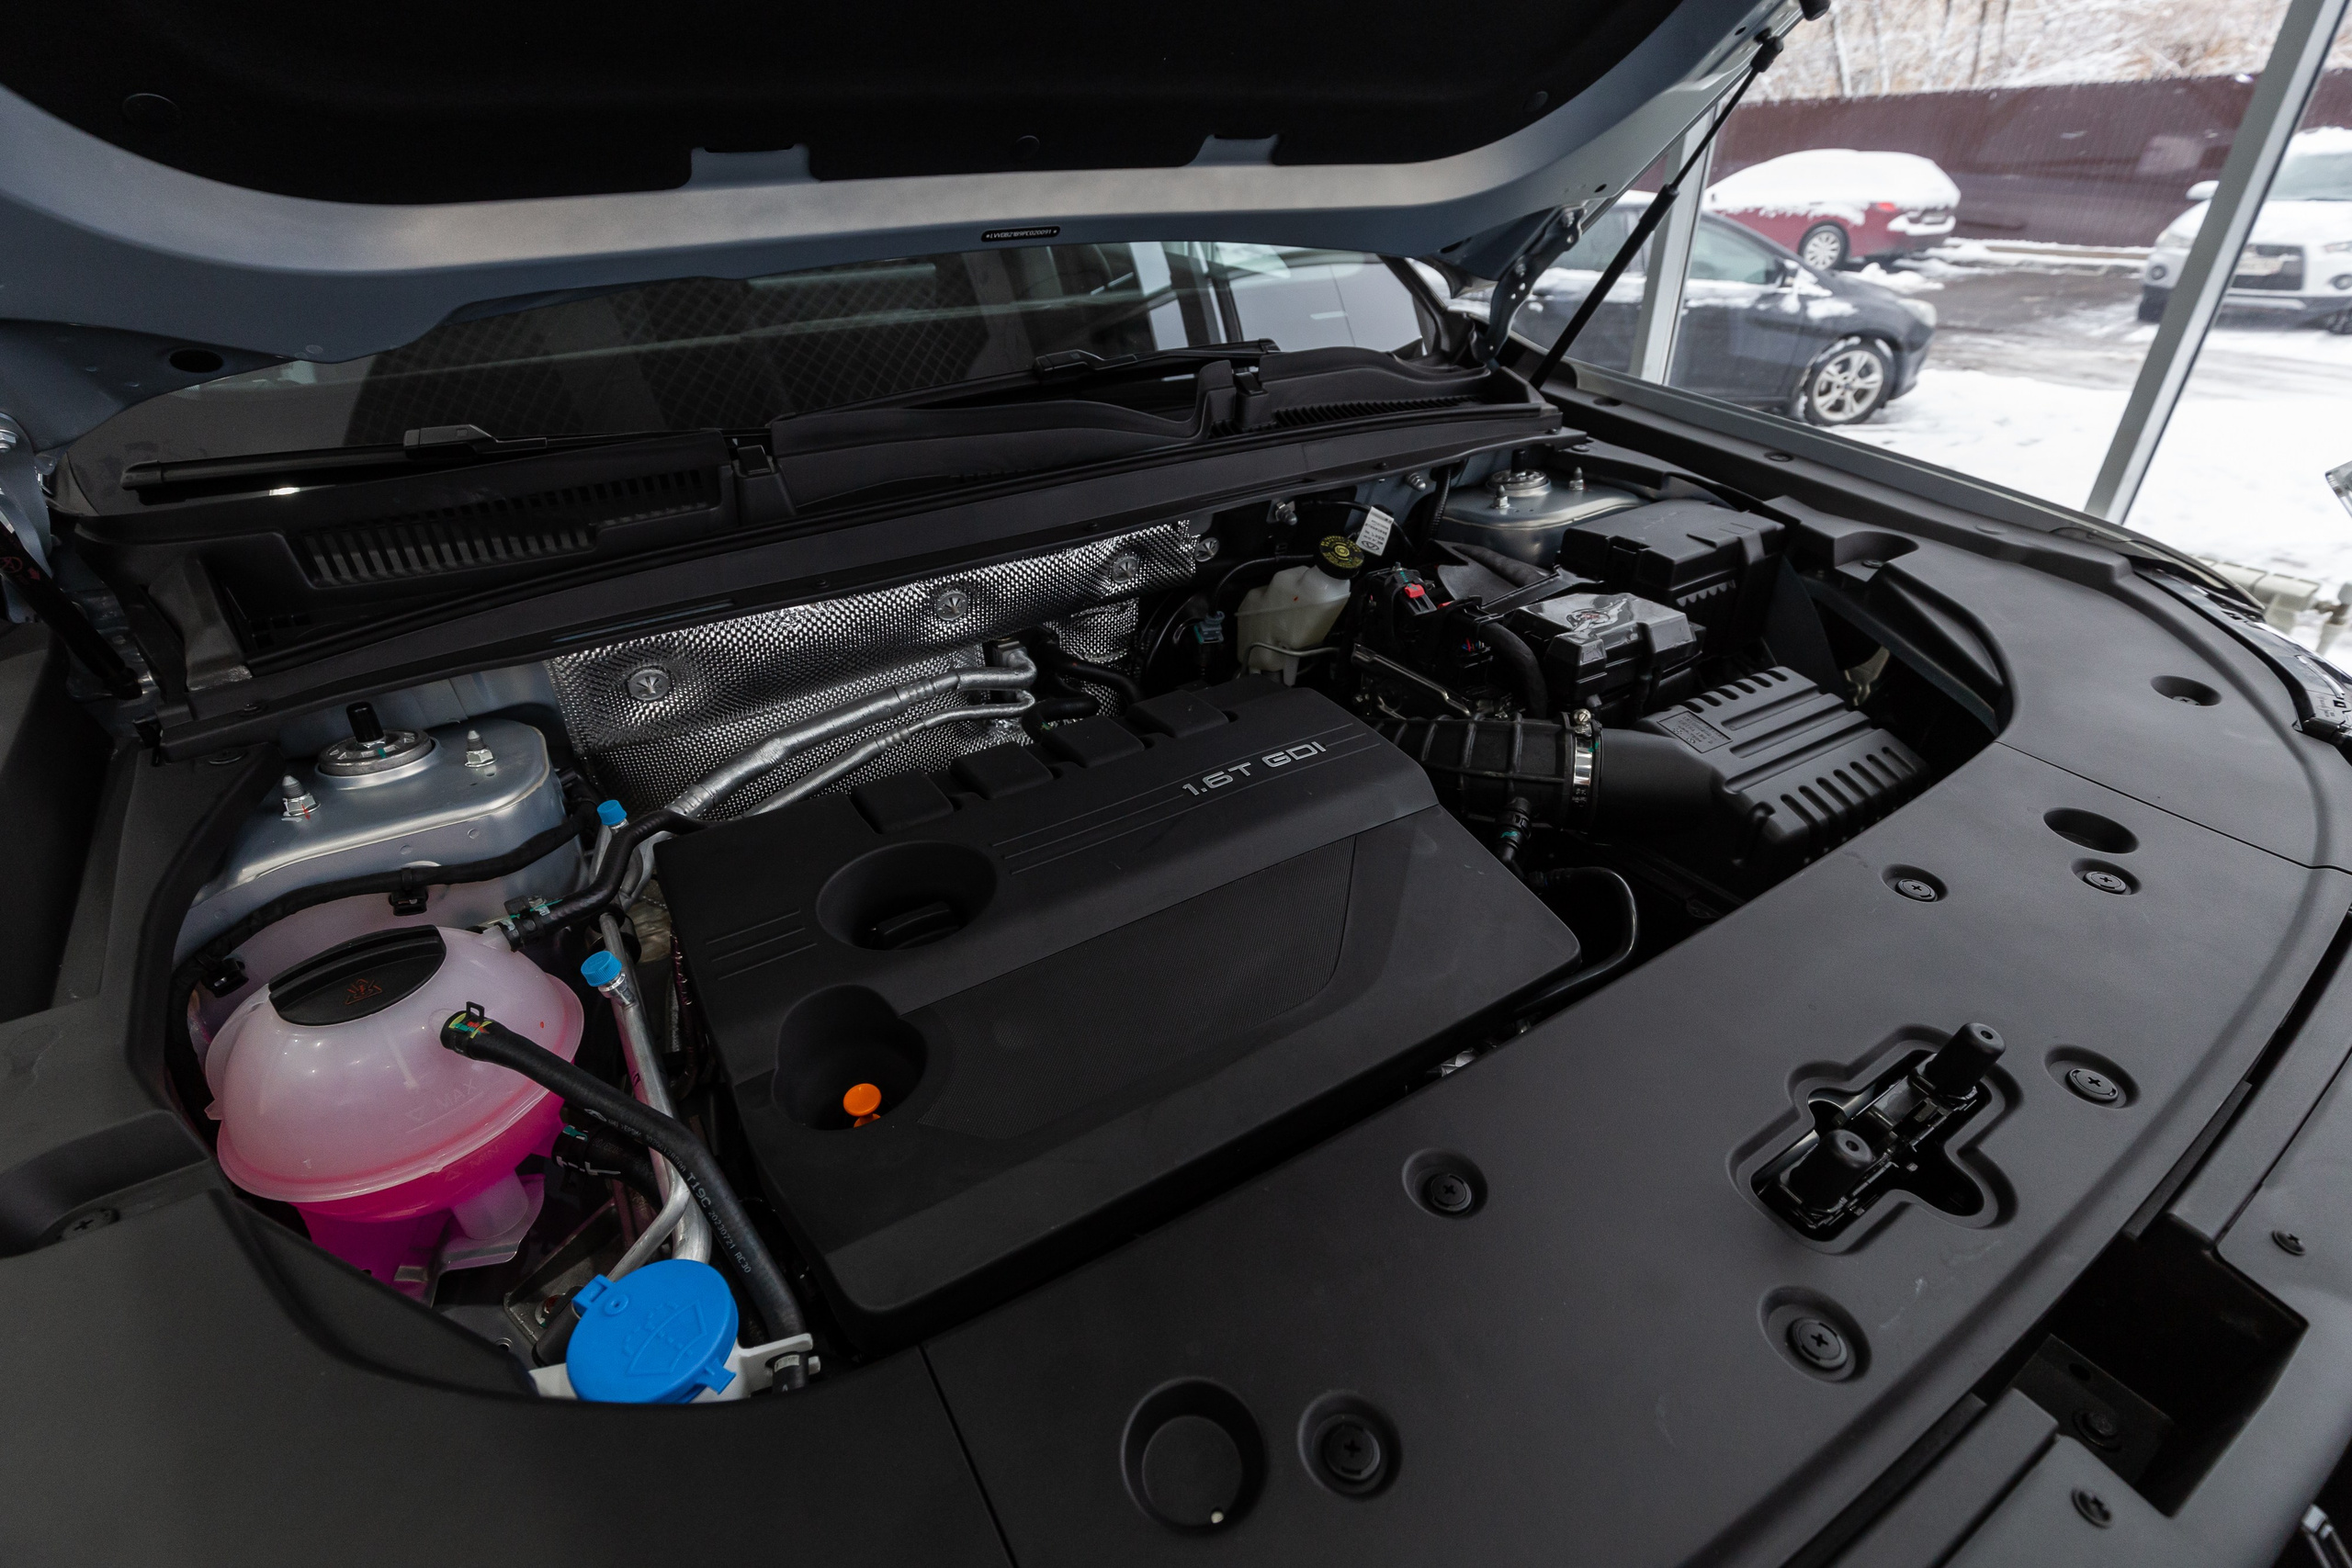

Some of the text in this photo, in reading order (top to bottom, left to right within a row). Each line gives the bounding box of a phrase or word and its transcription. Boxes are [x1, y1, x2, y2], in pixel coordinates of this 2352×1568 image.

[1182, 741, 1327, 796] 1.6T GDI
[686, 1171, 712, 1208] T19C
[707, 1211, 736, 1249] 20230721
[734, 1251, 752, 1273] RC30
